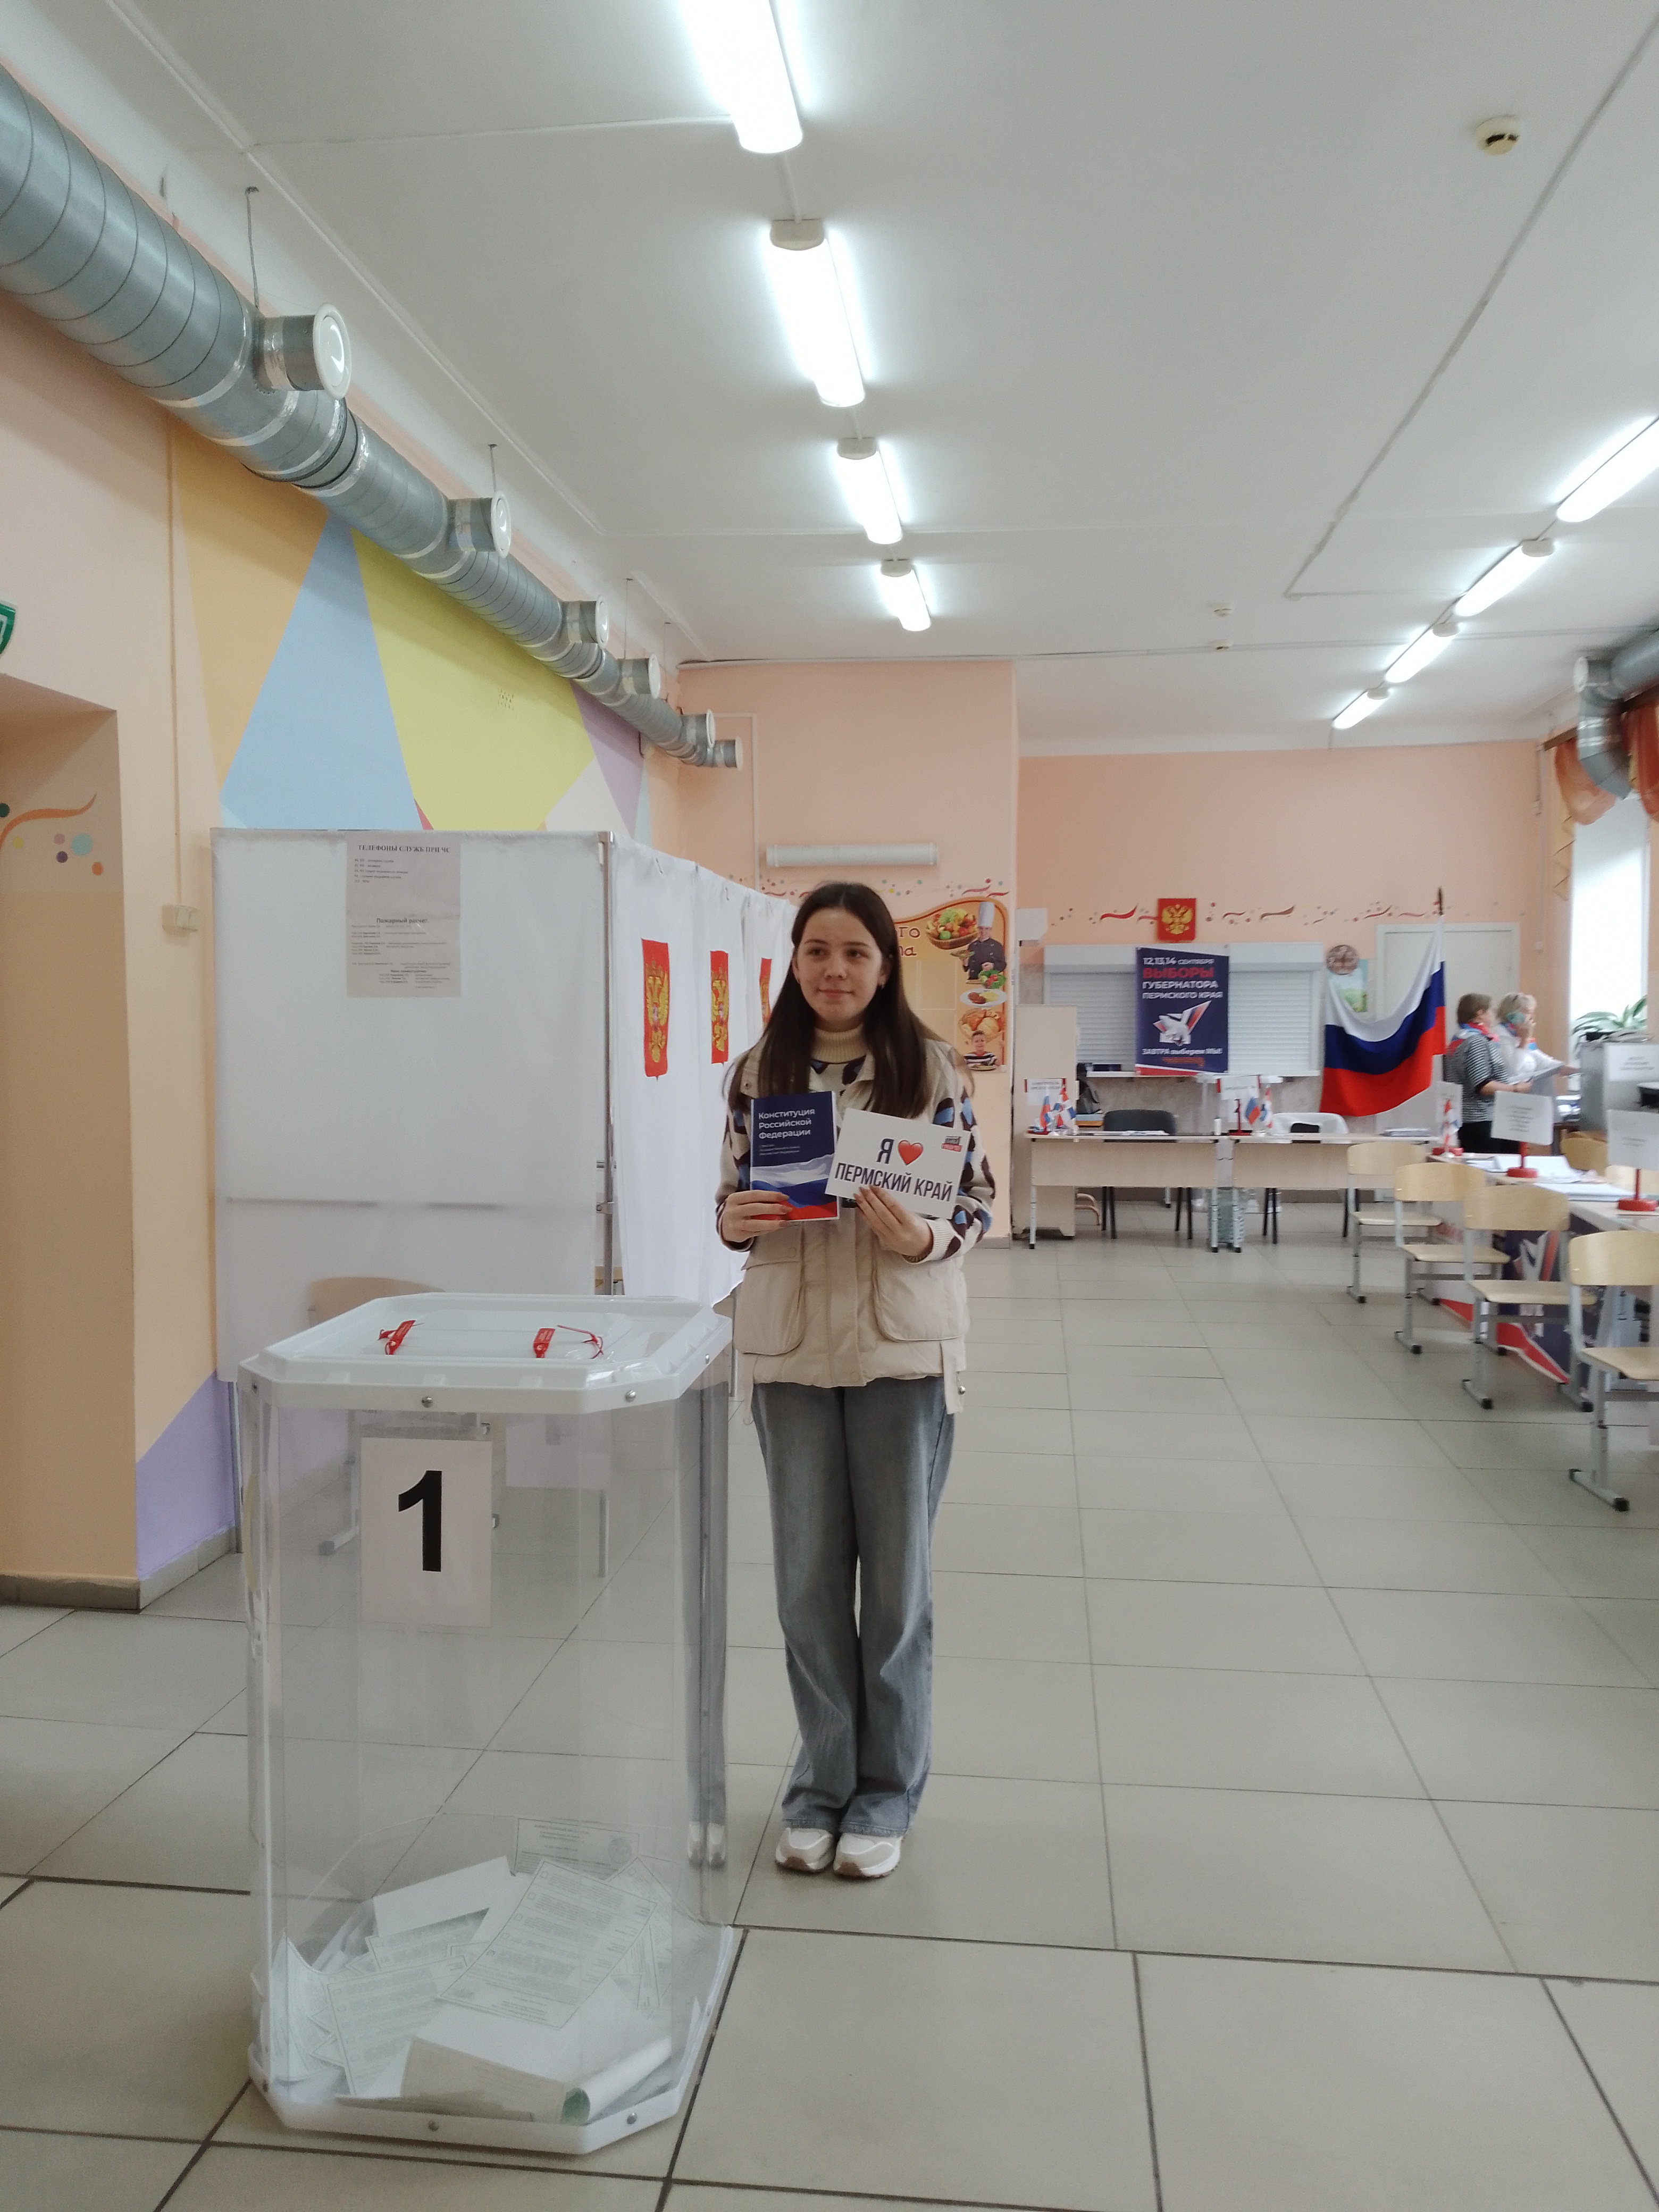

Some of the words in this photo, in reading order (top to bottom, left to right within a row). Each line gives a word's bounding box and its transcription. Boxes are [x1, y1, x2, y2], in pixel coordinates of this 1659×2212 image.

[1143, 967, 1214, 979] ВЫБОРЫ
[1142, 981, 1219, 989] ГУБЕРНАТОРА
[758, 1109, 815, 1120] Конституция
[758, 1118, 812, 1129] Российской
[758, 1129, 811, 1139] Федерации
[876, 1137, 894, 1164] Я
[834, 1162, 912, 1194] ПЕРМСКИЙ
[913, 1178, 954, 1202] КРАЙ
[398, 1470, 442, 1572] 1
